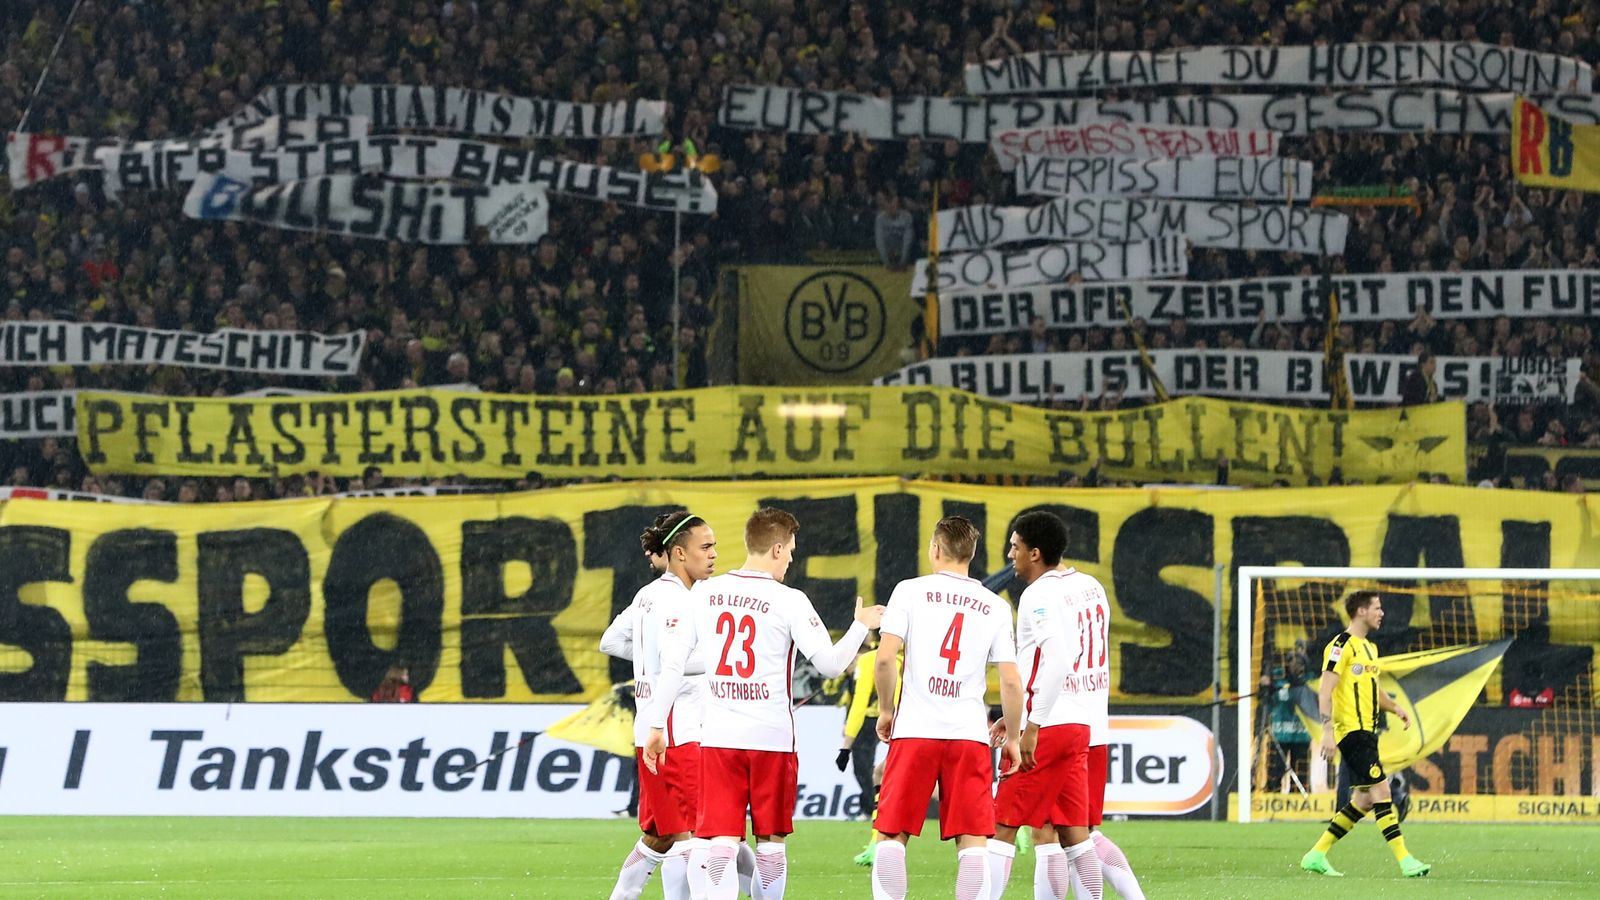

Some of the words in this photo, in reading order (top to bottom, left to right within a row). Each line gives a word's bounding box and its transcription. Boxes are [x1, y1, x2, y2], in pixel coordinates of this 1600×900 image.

[981, 50, 1188, 90] MINTZLAFF
[1222, 48, 1279, 80] DU
[529, 99, 647, 136] MAUL
[725, 86, 862, 133] EURE
[1261, 91, 1600, 133] GESCHWS
[1137, 126, 1203, 159] RED
[1519, 99, 1575, 177] RB
[118, 148, 227, 190] BIER
[251, 138, 437, 188] STATT
[1021, 155, 1188, 194] VERPISST
[1214, 156, 1300, 196] EUCH
[948, 206, 1003, 249] AUS
[1207, 205, 1338, 248] SPORT
[803, 281, 869, 341] BVB
[953, 290, 1034, 330] DER
[1052, 286, 1133, 323] DFB
[1407, 275, 1504, 313] DEN
[0, 325, 66, 362] ICH
[820, 344, 850, 361] 09
[950, 358, 1065, 397] BULL
[1085, 354, 1157, 392] IST
[1174, 354, 1260, 392] DER
[84, 395, 696, 466] PFLASTERSTEINE
[730, 392, 871, 463] AUF
[902, 391, 1015, 461] DIE
[710, 594, 723, 607] RB
[727, 594, 770, 614] LEIPZIG
[926, 591, 942, 602] RB
[946, 592, 991, 615] LEIPZIG
[715, 611, 757, 679] 23
[940, 612, 964, 675] 4
[150, 730, 632, 793] Tankstellen
[1252, 799, 1326, 813] SIGNAL
[1418, 799, 1470, 813] PARK
[1518, 800, 1591, 816] SIGNAL
